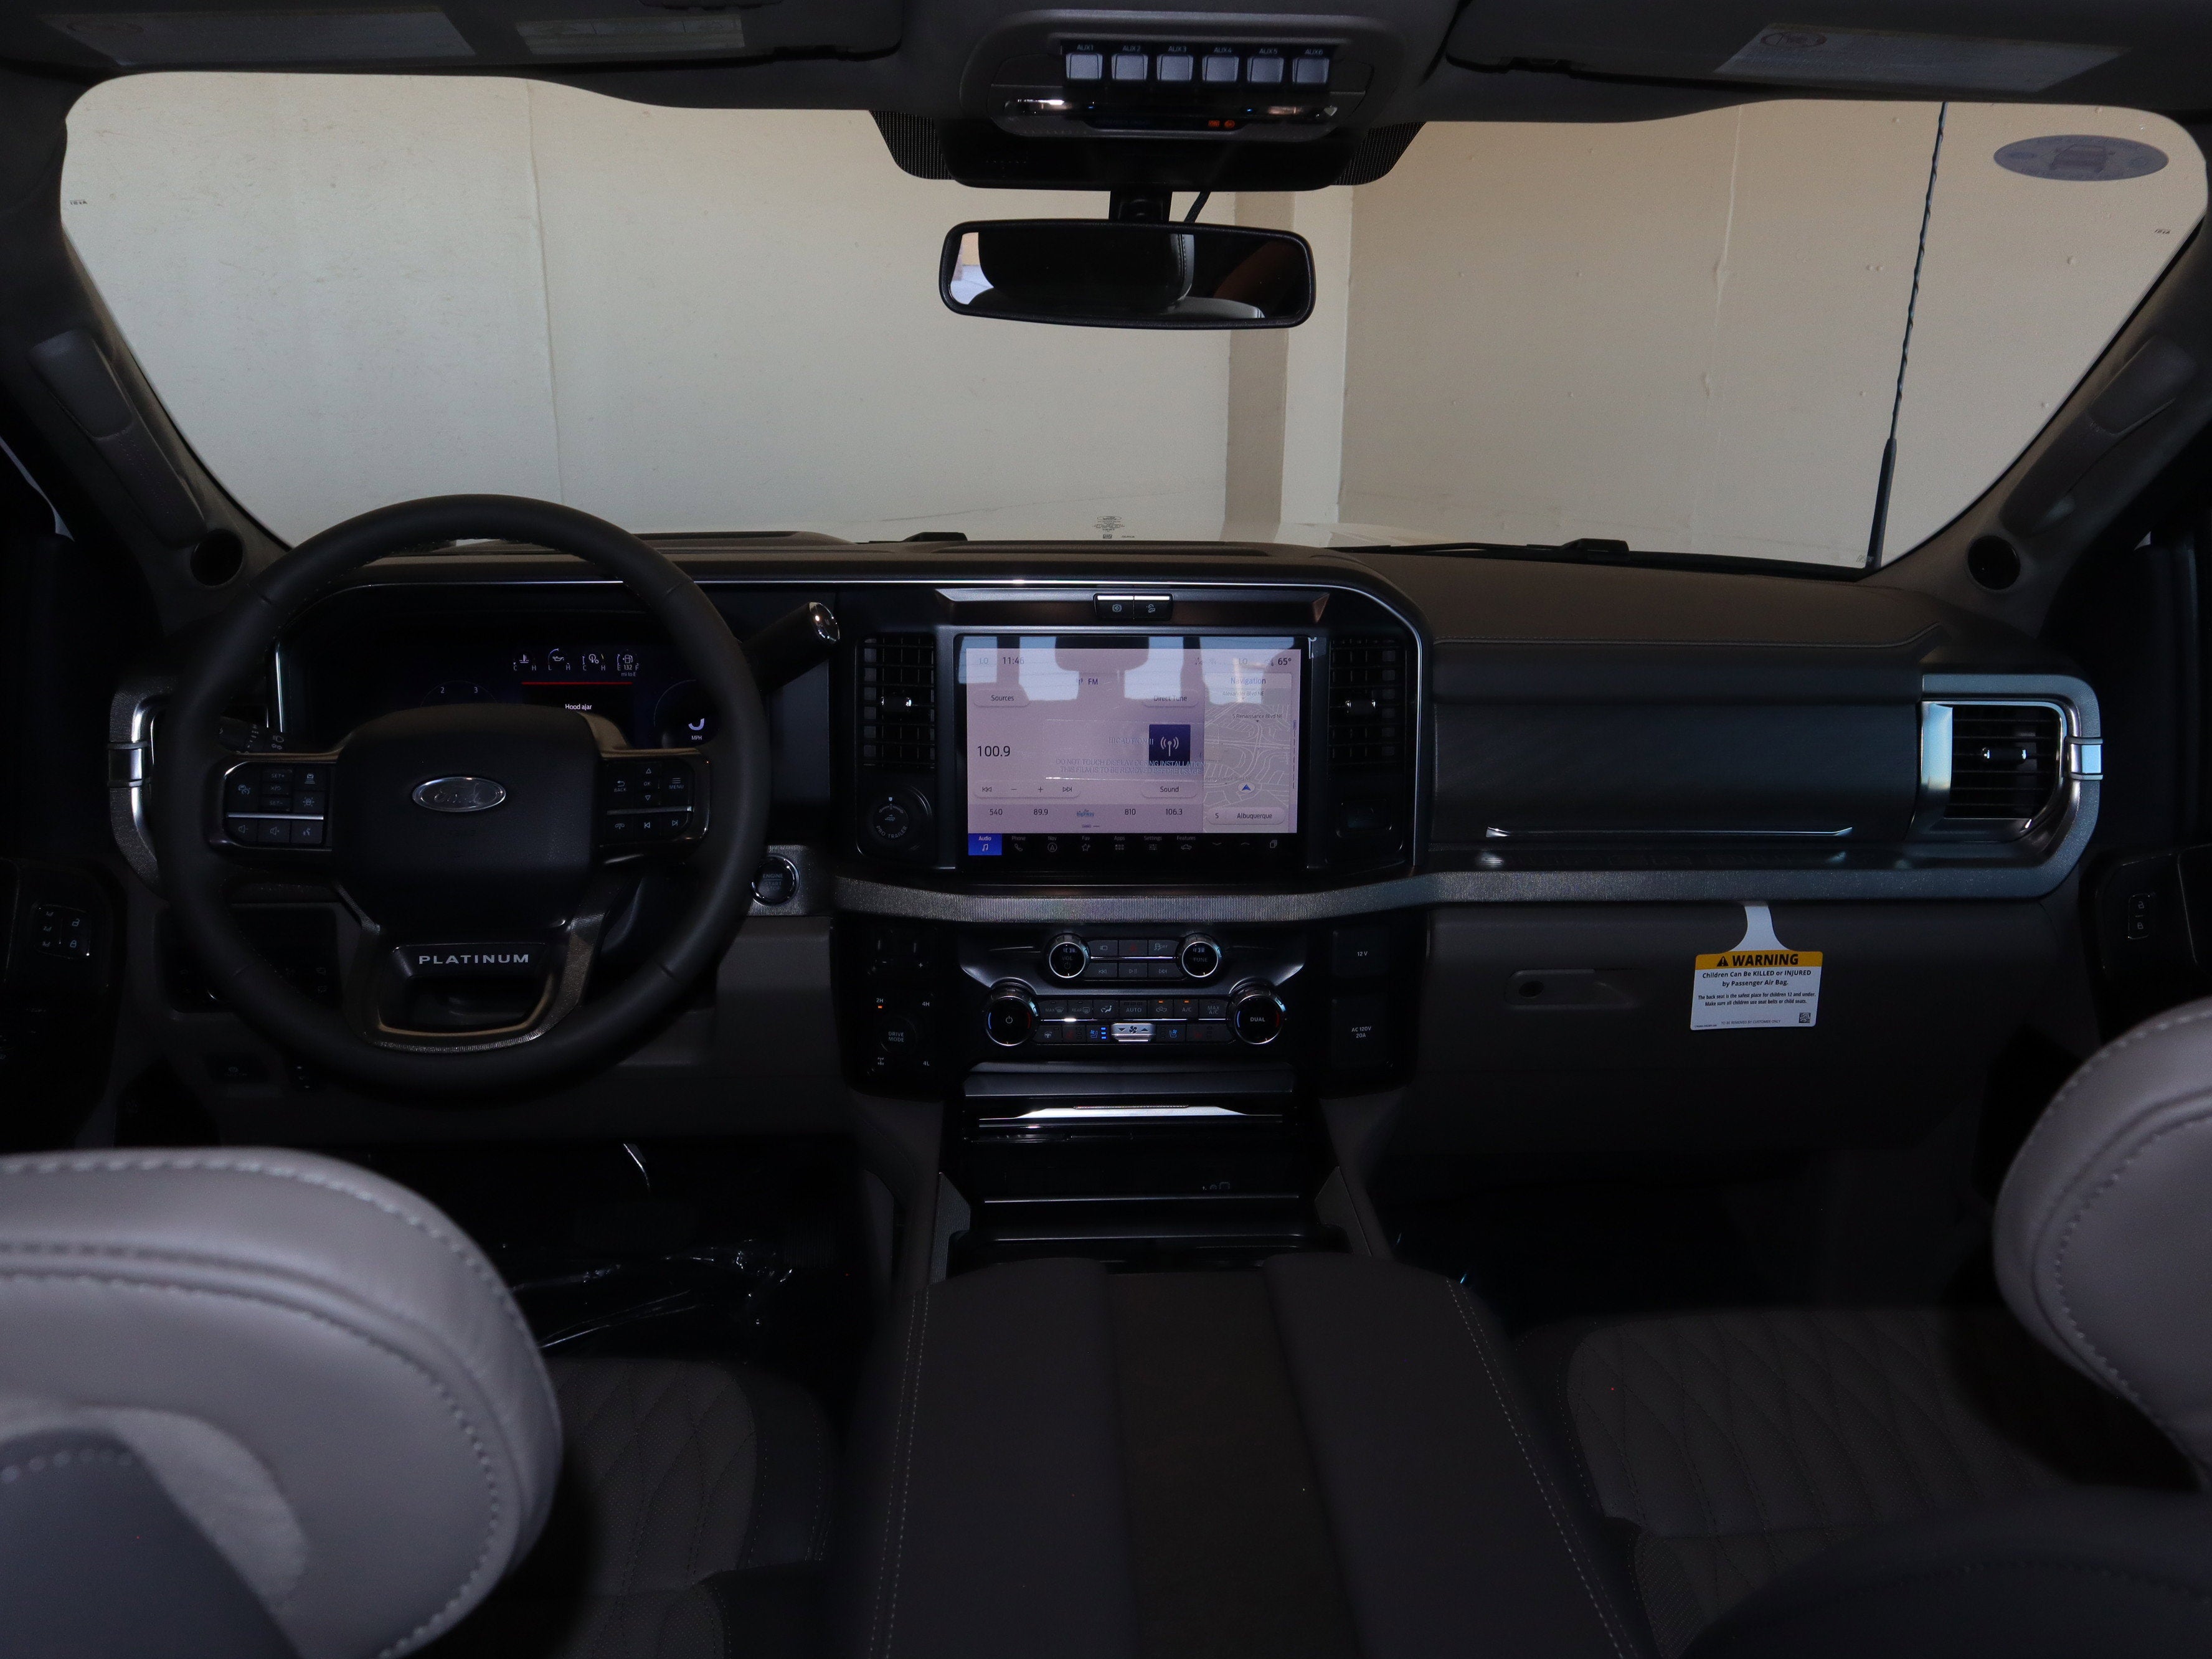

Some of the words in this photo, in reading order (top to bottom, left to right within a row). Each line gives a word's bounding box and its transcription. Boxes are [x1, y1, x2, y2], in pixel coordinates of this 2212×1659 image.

[977, 745, 1011, 757] 100.9
[419, 954, 529, 965] PLATINUM
[1732, 953, 1799, 967] WARNING
